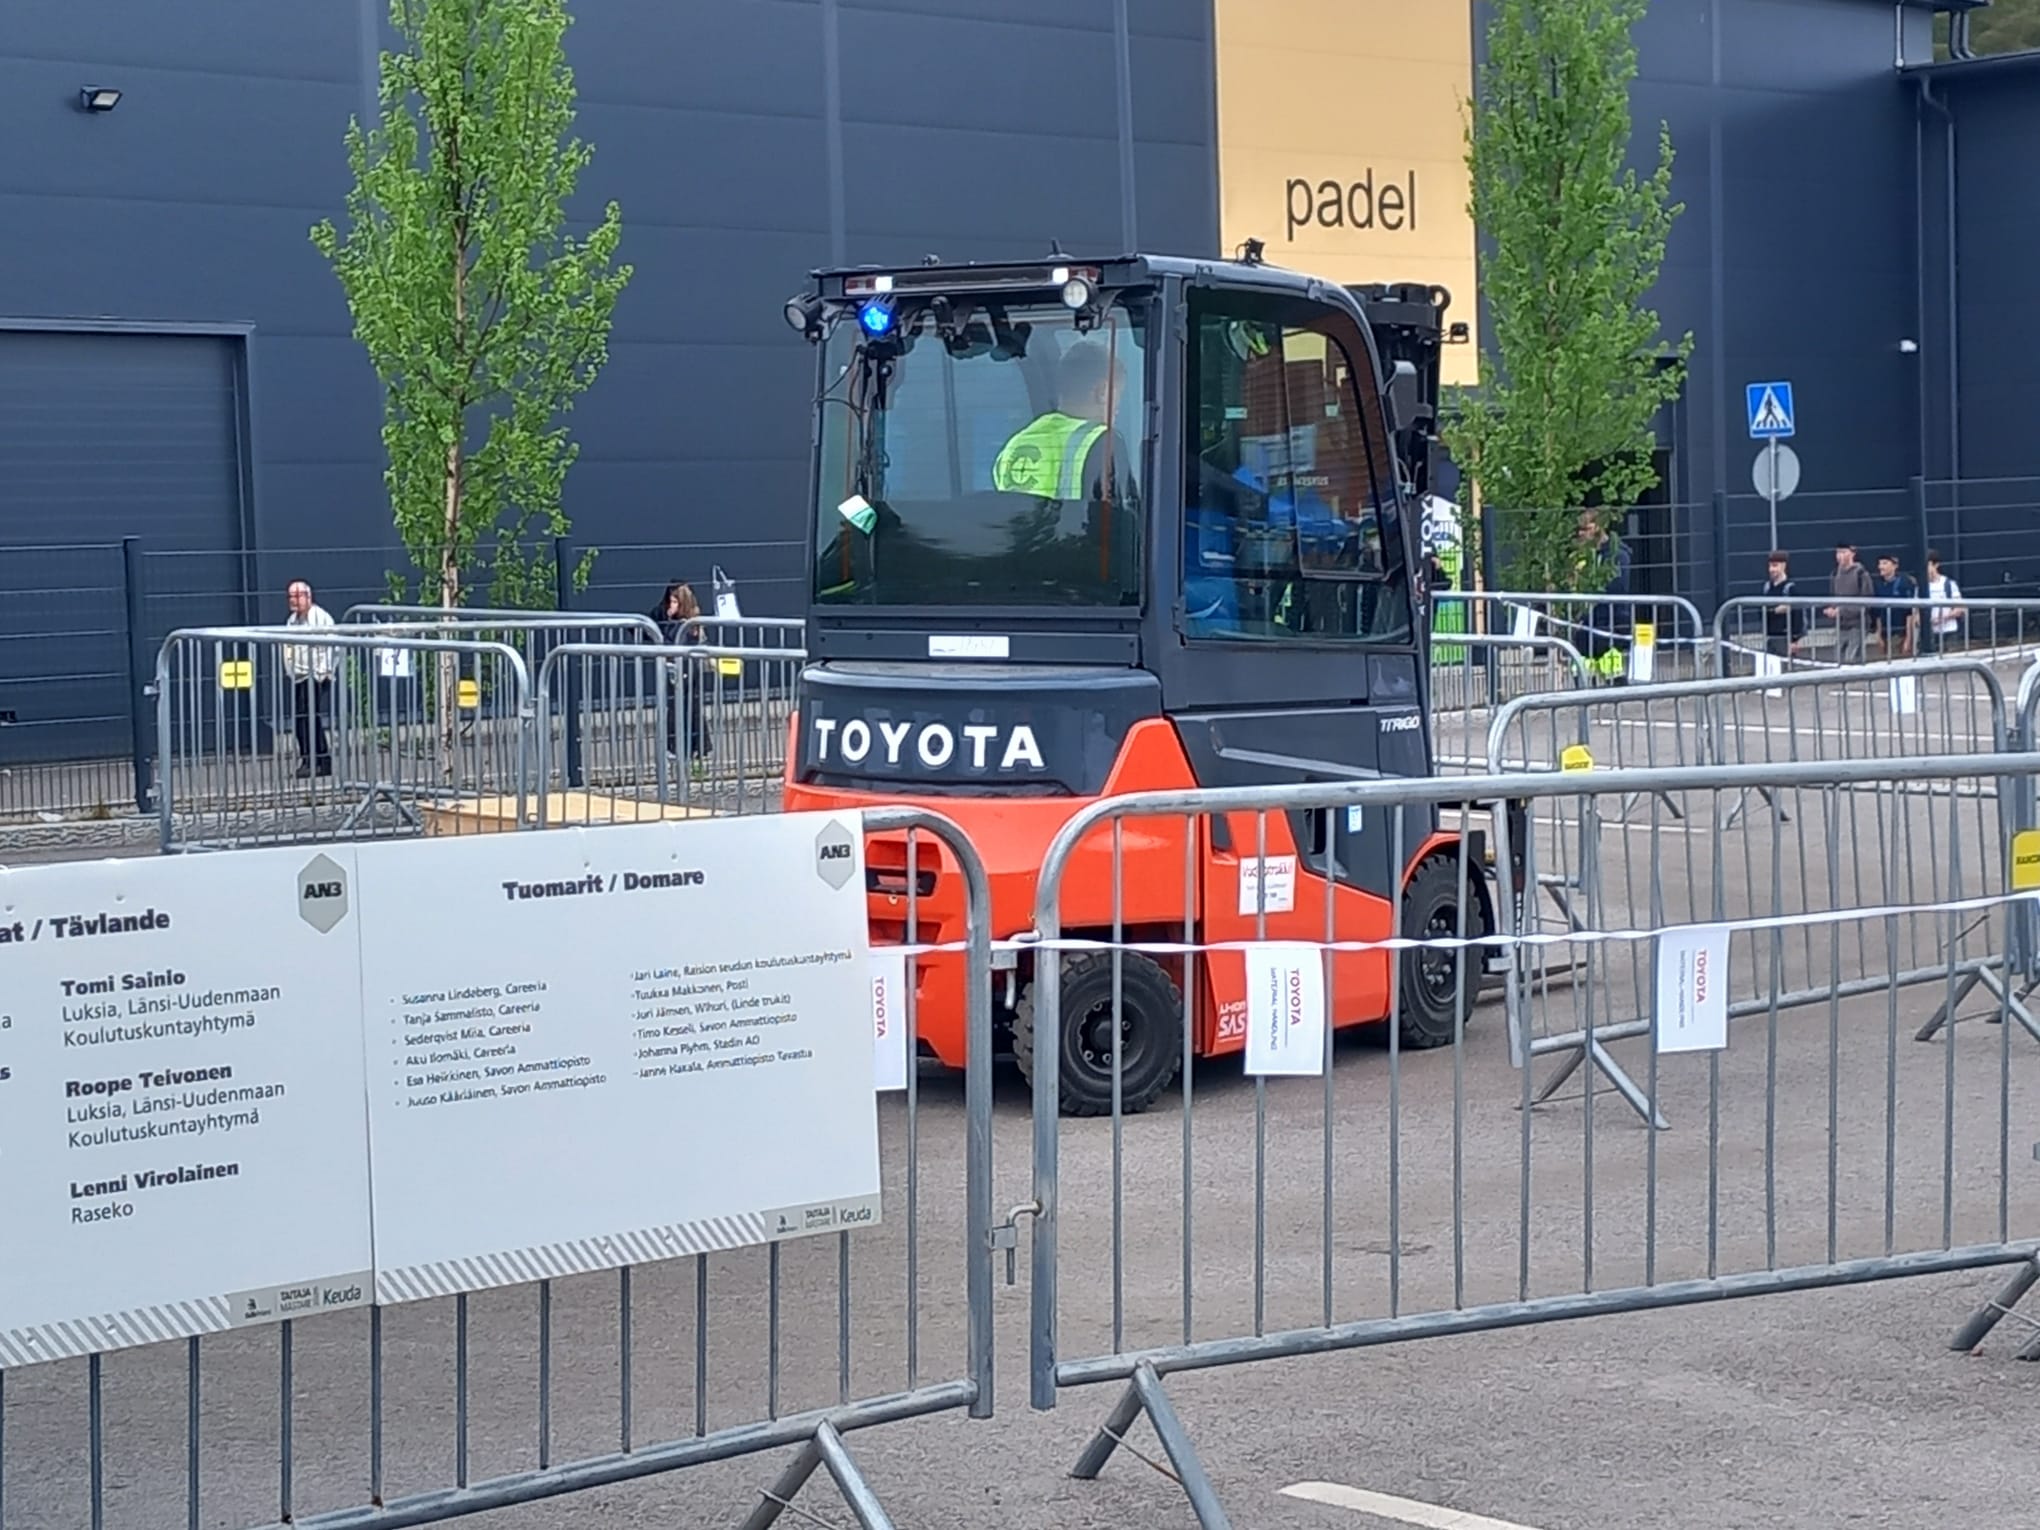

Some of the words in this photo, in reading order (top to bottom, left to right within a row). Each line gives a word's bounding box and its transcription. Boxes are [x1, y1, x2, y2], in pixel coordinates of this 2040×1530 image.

[1286, 167, 1415, 242] padel
[815, 718, 1045, 768] TOYOTA
[817, 844, 852, 860] AN3
[303, 881, 343, 900] AN3
[502, 875, 603, 900] Tuomarit
[623, 869, 705, 890] Domare
[50, 908, 170, 938] Tävlande
[61, 976, 115, 997] Tomi
[121, 969, 186, 991] Sainio
[1695, 950, 1707, 1003] TOYOTA
[62, 1000, 123, 1023] Luksia,
[128, 986, 281, 1016] Länsi-Uudenmaan
[874, 976, 886, 1038] TOYOTA
[1289, 967, 1301, 1026] TOYOTA
[64, 1011, 256, 1047] Koulutuskuntayhtymä
[66, 1077, 133, 1098] Roope
[139, 1065, 233, 1089] Teivonen
[67, 1101, 127, 1123] Luksia,
[132, 1082, 285, 1115] Länsi-Uudenmaan
[68, 1107, 260, 1148] Koulutuskuntayhtymä
[70, 1175, 127, 1199] Lenni
[134, 1162, 240, 1190] Virolainen
[71, 1201, 134, 1224] Raseko
[322, 1284, 362, 1305] Keuda
